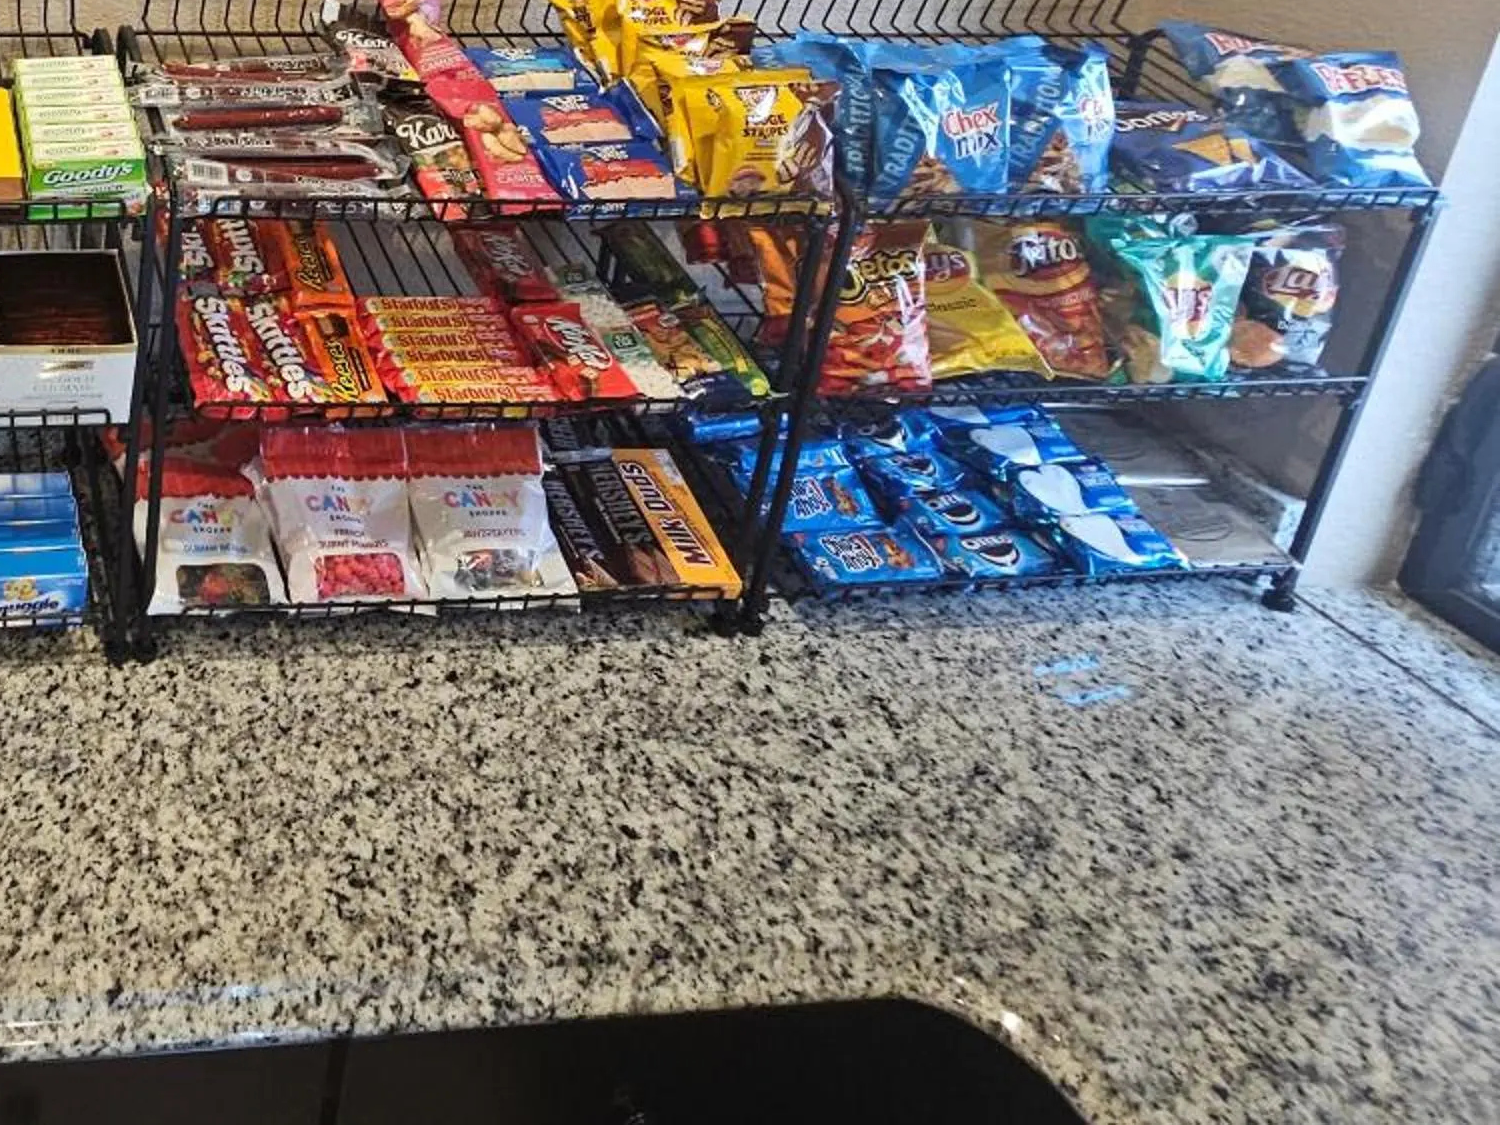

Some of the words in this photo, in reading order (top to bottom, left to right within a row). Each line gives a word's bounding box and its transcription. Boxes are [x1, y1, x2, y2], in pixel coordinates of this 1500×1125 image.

[944, 104, 999, 136] Chex
[43, 162, 133, 185] Goody's
[381, 299, 459, 311] Starburst
[390, 315, 467, 328] Starburst
[195, 296, 248, 393] Skittles
[397, 332, 475, 346] Starburst
[253, 300, 313, 400] Skittles
[406, 349, 487, 363] Starburst
[417, 368, 500, 382] Starburst
[434, 386, 515, 401] Starburst
